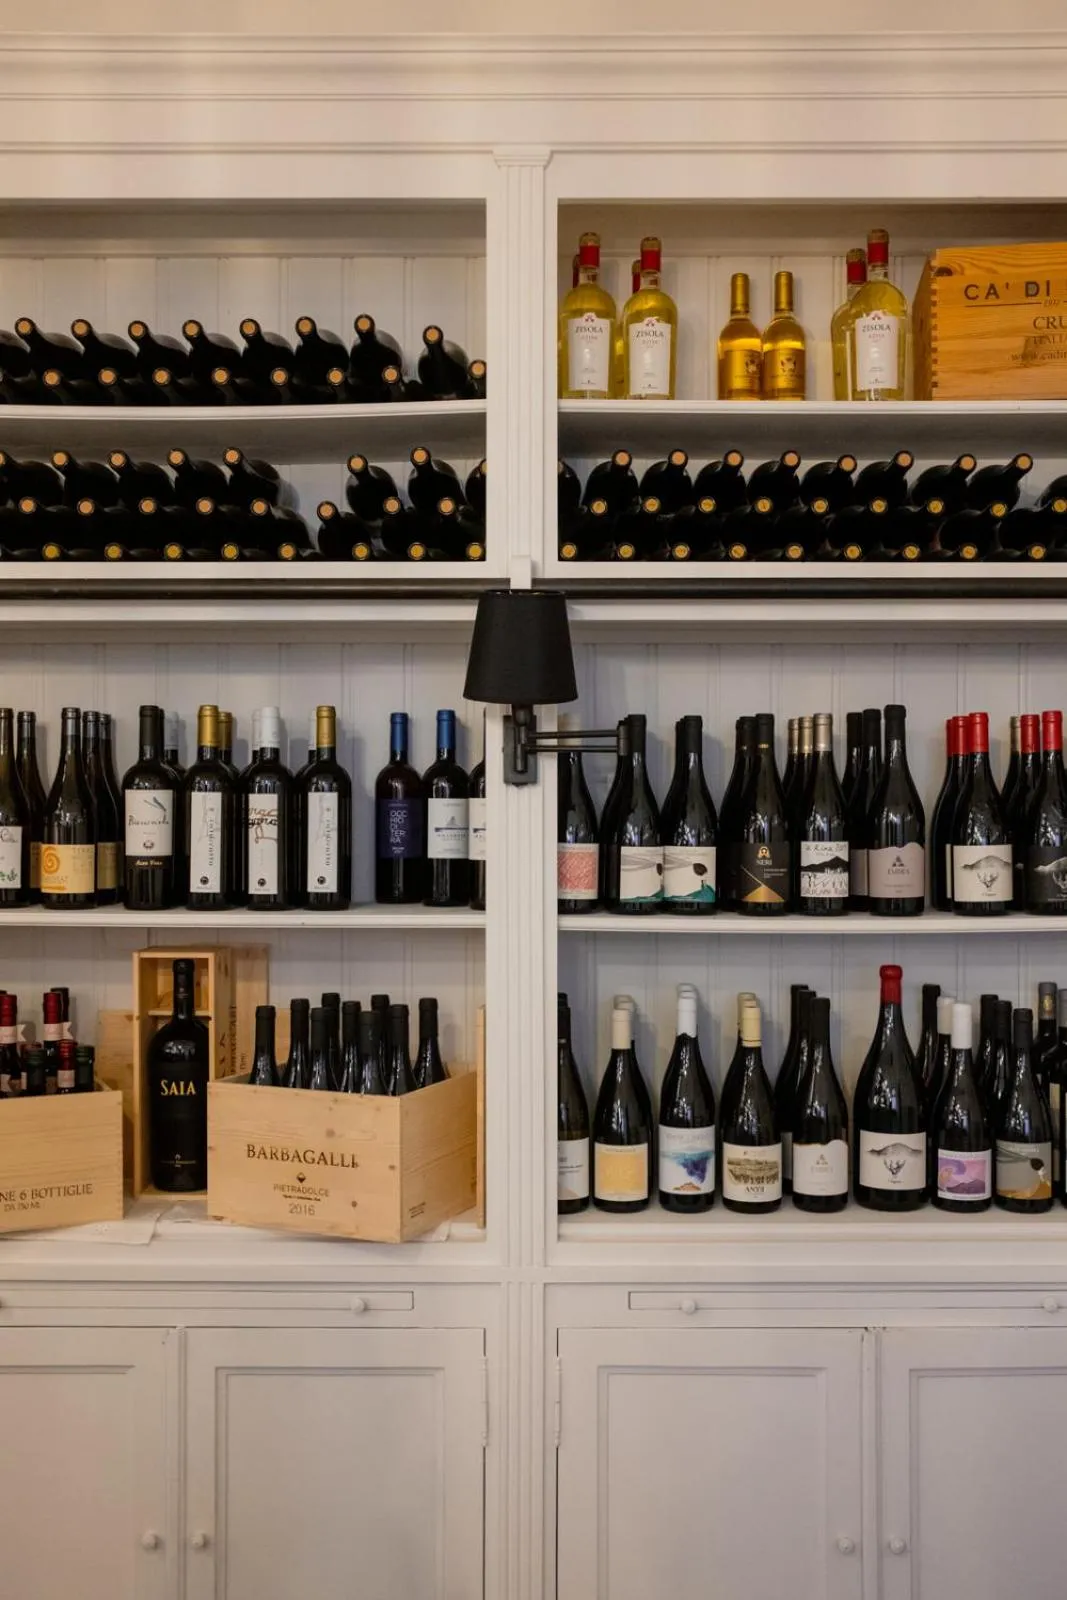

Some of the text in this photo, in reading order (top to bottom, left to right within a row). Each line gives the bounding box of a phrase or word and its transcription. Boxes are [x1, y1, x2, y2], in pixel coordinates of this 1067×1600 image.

[964, 280, 1050, 301] CA' DI
[575, 326, 604, 334] ZISOLA
[636, 330, 665, 338] ZISOLA
[862, 323, 892, 333] ZISOLA
[160, 1079, 197, 1096] SAIA
[246, 1143, 359, 1169] BARBAGALLI
[19, 1189, 28, 1201] 6
[31, 1183, 94, 1200] BOTTIGLIE
[272, 1183, 330, 1197] PIETRADOLCE
[288, 1203, 316, 1216] 2016
